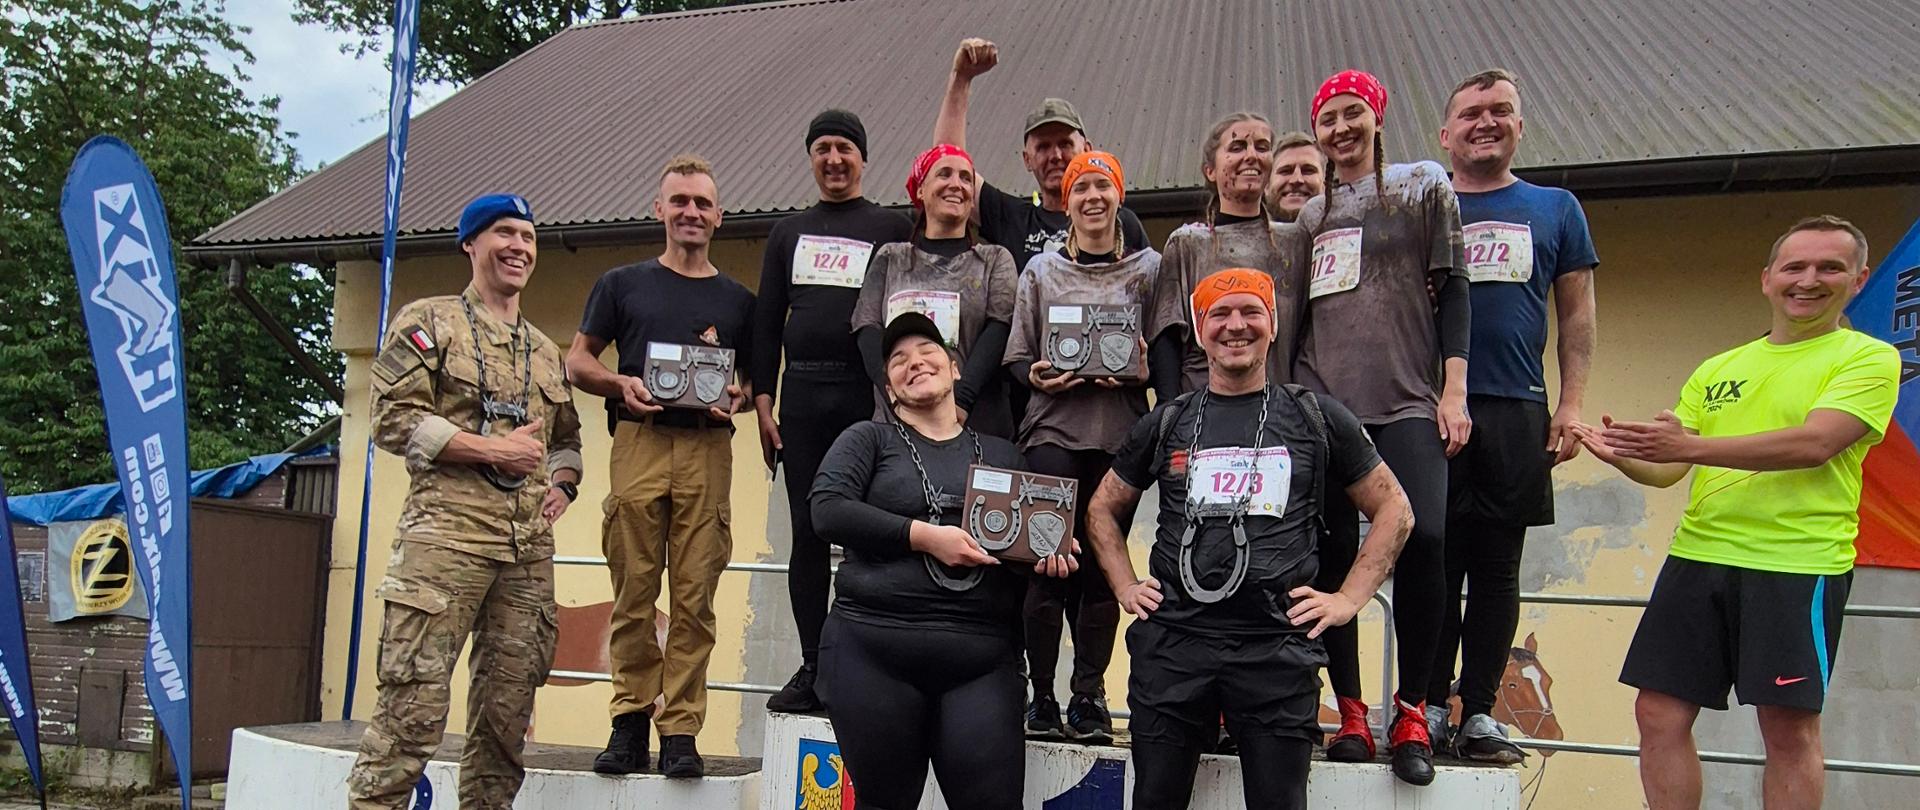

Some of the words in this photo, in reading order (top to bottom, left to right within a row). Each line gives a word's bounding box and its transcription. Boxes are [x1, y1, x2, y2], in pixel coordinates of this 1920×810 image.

[813, 253, 850, 270] 12/4
[1463, 242, 1510, 265] 12/2
[1892, 264, 1920, 386] META
[1703, 379, 1748, 404] XIX
[1211, 472, 1264, 494] 12/3
